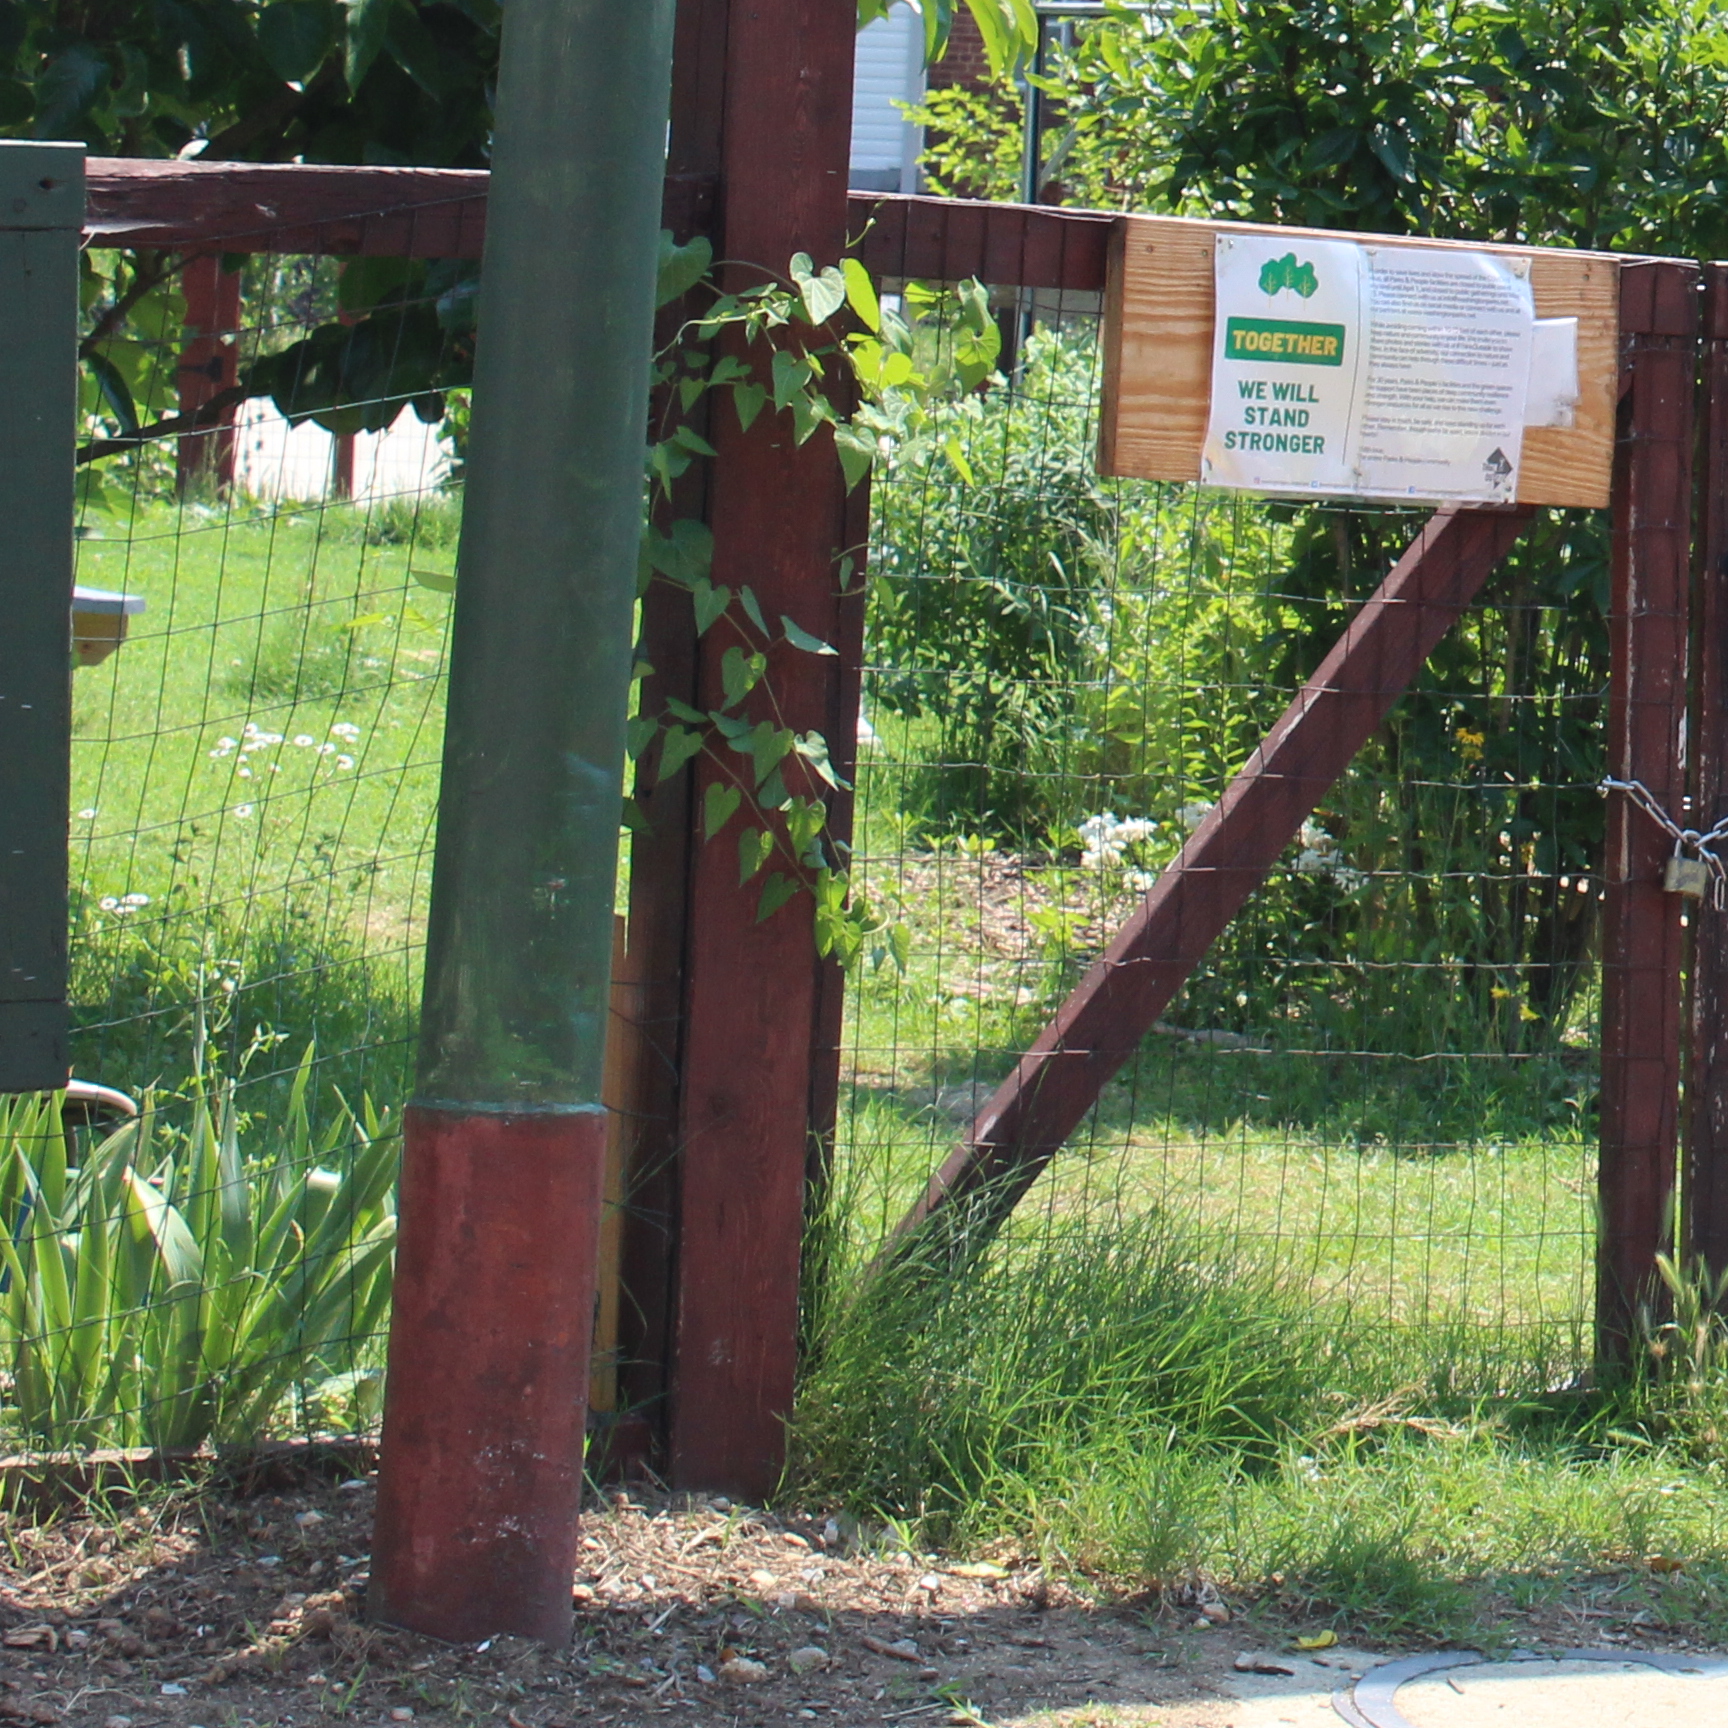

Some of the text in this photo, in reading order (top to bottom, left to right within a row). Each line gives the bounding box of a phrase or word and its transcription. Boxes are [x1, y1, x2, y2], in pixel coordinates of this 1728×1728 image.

[1232, 329, 1338, 357] TOGETHER
[1238, 379, 1320, 404] WE WILL
[1244, 405, 1310, 428] STAND
[1224, 430, 1326, 455] STRONGER
